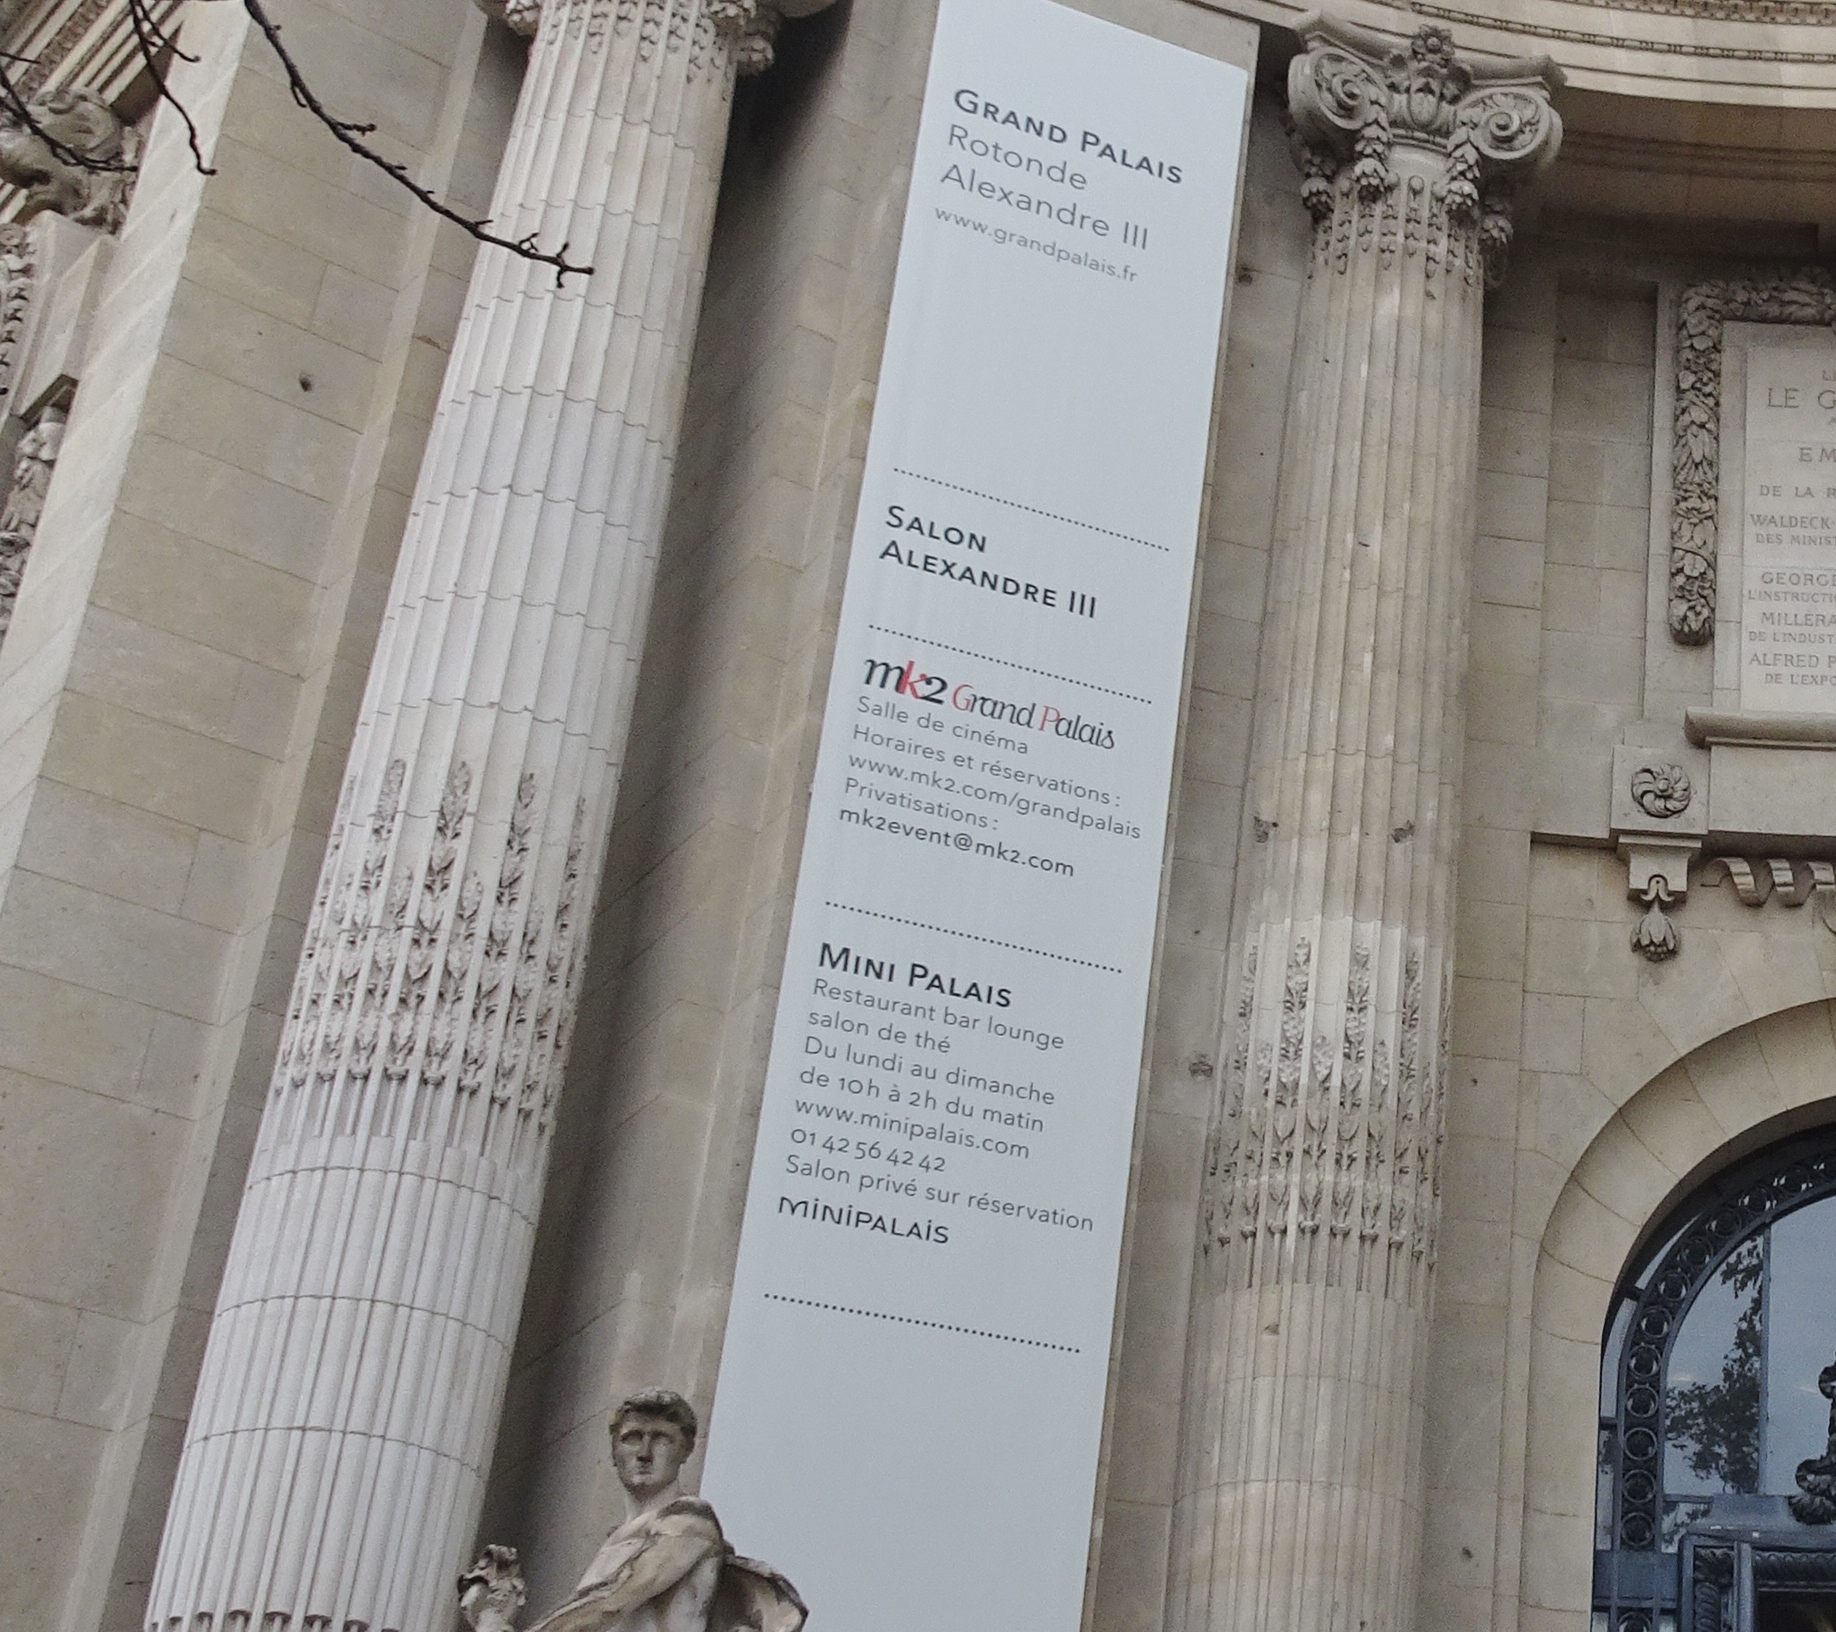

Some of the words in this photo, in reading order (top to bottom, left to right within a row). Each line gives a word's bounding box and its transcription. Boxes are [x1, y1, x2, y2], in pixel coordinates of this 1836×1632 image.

[947, 123, 1087, 190] Rotonde
[953, 88, 1067, 144] GRAND
[1080, 129, 1182, 184] PALAIS
[939, 163, 1110, 237] Alexandre
[1122, 220, 1148, 250] III
[934, 207, 1137, 282] www.grandpalais.fr
[1767, 387, 1799, 409] LE
[1759, 484, 1782, 497] DE
[1794, 486, 1815, 499] LA
[885, 504, 986, 553] SALON
[1756, 533, 1783, 545] DES
[878, 539, 1057, 608] ALEXANDRE
[1068, 589, 1096, 618] III
[1749, 631, 1766, 642] DE
[1749, 652, 1820, 668] ALFRED
[863, 658, 948, 705] mk2
[951, 683, 1036, 729] Grand
[1038, 705, 1115, 750] Palais
[1764, 673, 1783, 685] DE
[852, 722, 945, 762] Horaires
[952, 753, 974, 770] et
[856, 694, 909, 724] Salle
[915, 711, 945, 733] de
[951, 723, 1028, 754] cinéma
[848, 754, 1141, 839] www.mk2.com/grandpalais
[838, 807, 1074, 877] mk2event@mk2.com
[818, 941, 895, 982] MINI
[907, 962, 1011, 1008] PALAIS
[807, 1010, 869, 1036] salon
[876, 1022, 907, 1044] de
[914, 1029, 951, 1054] thé
[812, 977, 936, 1022] Restaurant
[942, 1005, 981, 1030] bar
[986, 1014, 1064, 1051] lounge
[798, 1065, 830, 1088] de
[838, 1076, 880, 1098] 10h
[887, 1083, 901, 1103] à
[908, 1088, 937, 1110] 2h
[944, 1094, 974, 1118] du
[981, 1107, 1044, 1132] matin
[803, 1034, 837, 1059] Du
[845, 1042, 903, 1073] lundi
[909, 1062, 937, 1080] au
[944, 1066, 1055, 1105] dimanche
[789, 1127, 816, 1146] 01
[821, 1134, 850, 1154] 42
[853, 1140, 881, 1160] 56
[885, 1147, 914, 1166] 42
[917, 1153, 946, 1173] 42
[794, 1098, 1029, 1159] www.minipalais.com
[784, 1153, 850, 1184] Salon
[857, 1173, 917, 1197] privé
[924, 1186, 960, 1204] sur
[967, 1191, 1093, 1231] réservation
